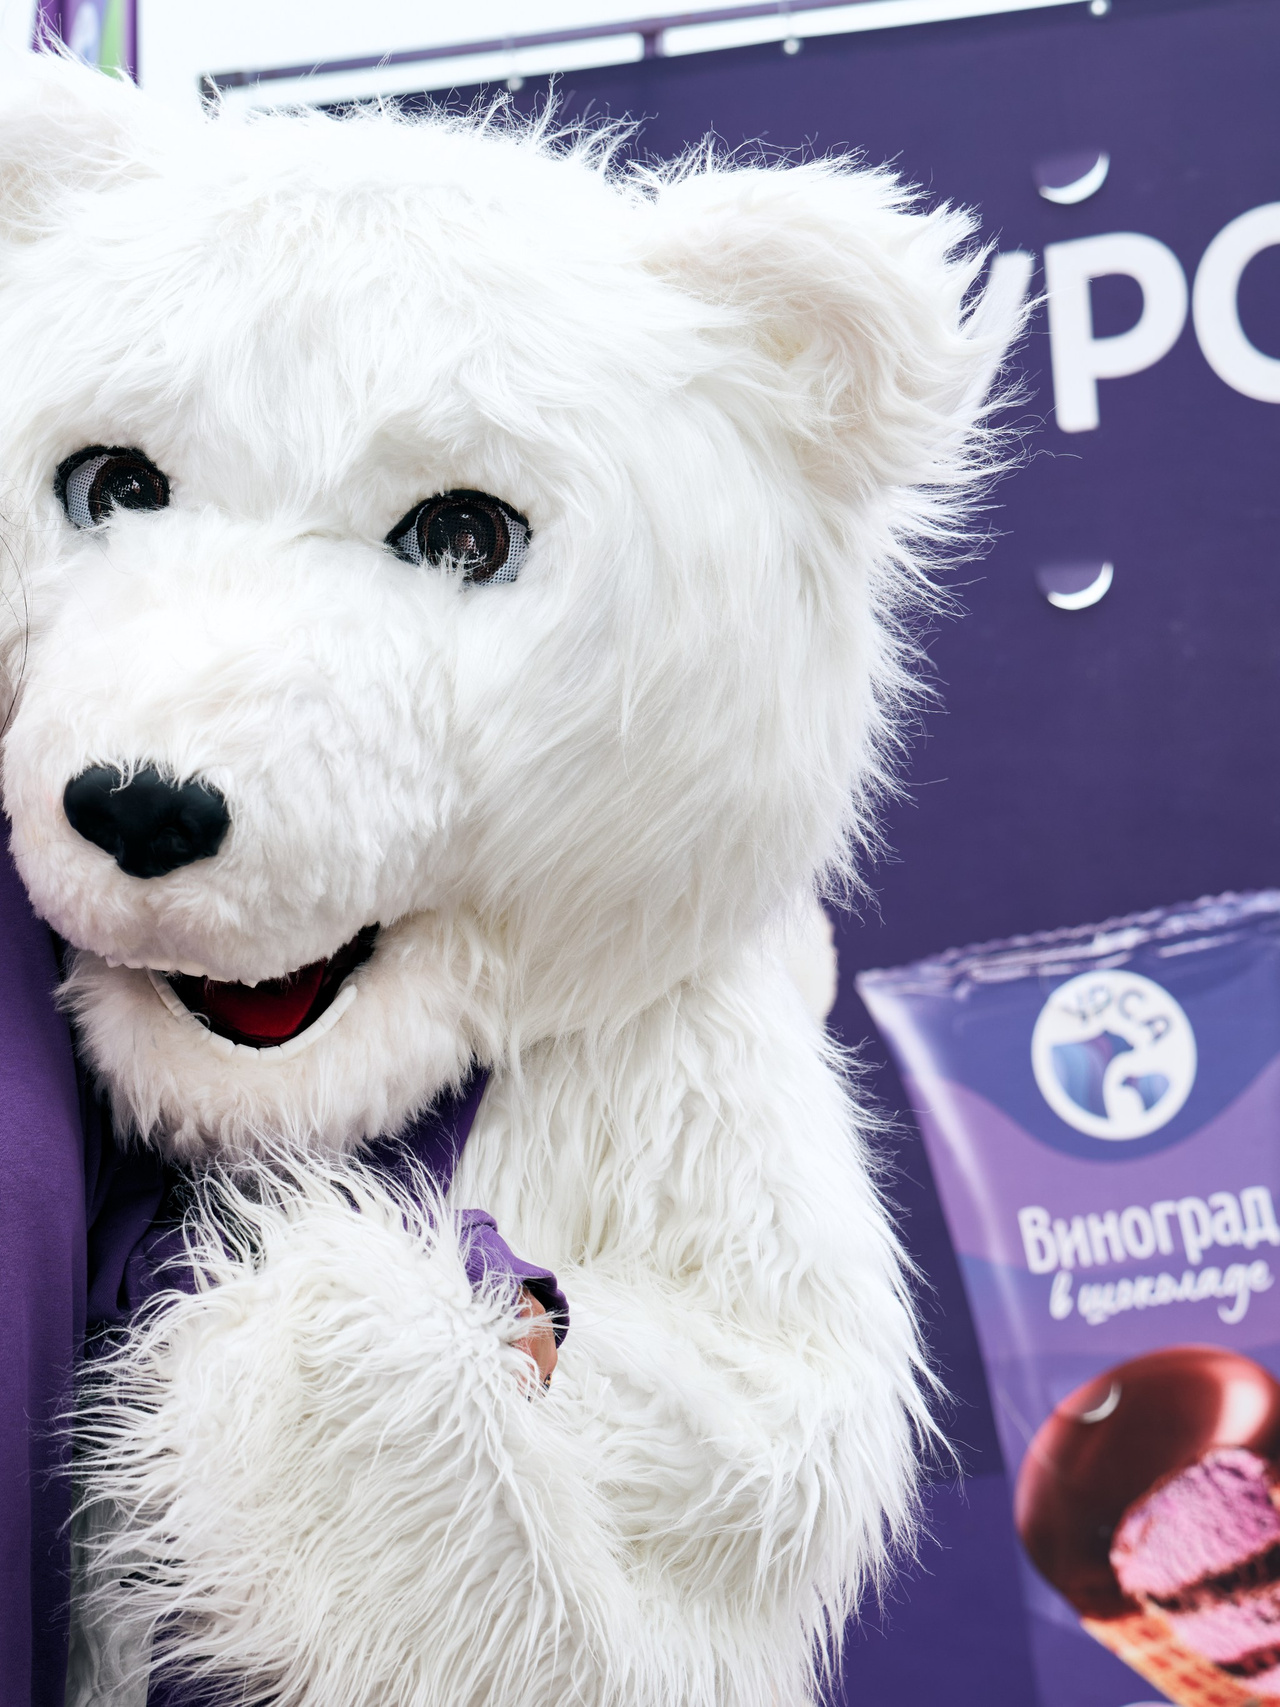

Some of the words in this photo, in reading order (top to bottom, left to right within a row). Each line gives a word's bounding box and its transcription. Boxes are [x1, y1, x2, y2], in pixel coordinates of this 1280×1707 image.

[1060, 984, 1173, 1046] УРСА
[1017, 1184, 1280, 1275] Виноград
[1049, 1269, 1074, 1321] в
[1077, 1259, 1274, 1326] шоколаде
